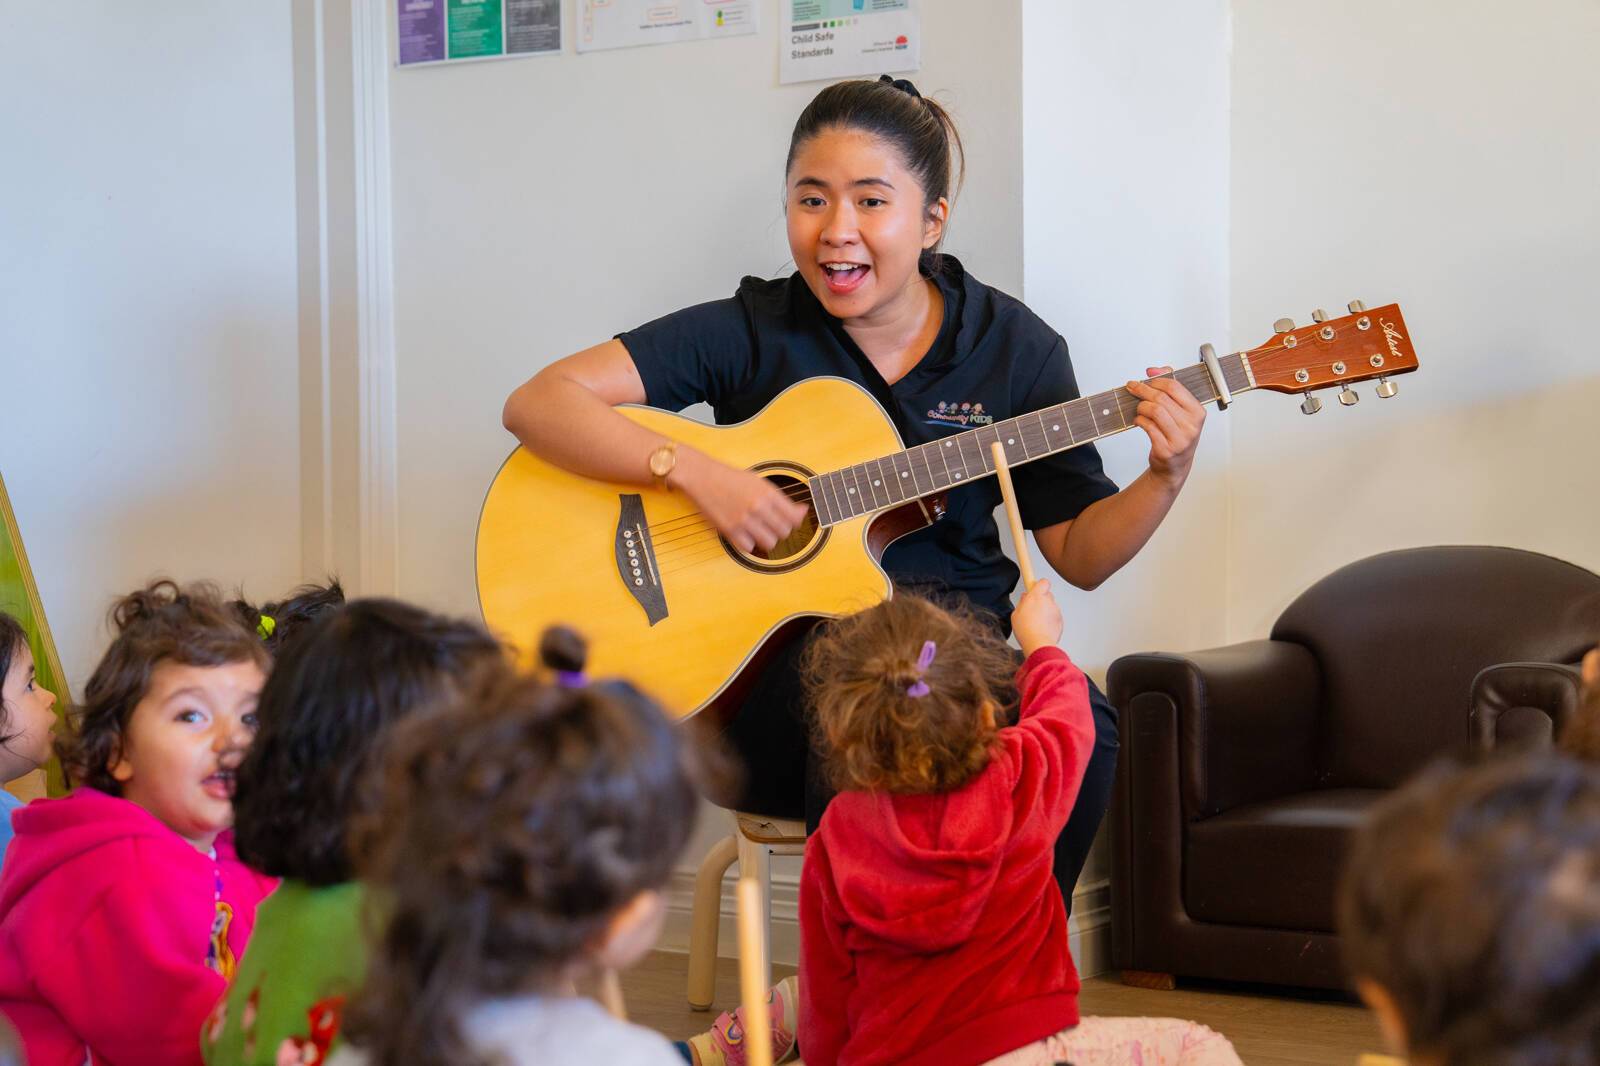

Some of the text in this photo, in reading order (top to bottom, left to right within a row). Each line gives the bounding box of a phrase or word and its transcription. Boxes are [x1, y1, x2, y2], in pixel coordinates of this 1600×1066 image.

[791, 32, 834, 45] Child Safe
[791, 47, 834, 59] Standards
[969, 414, 993, 424] KIDS
